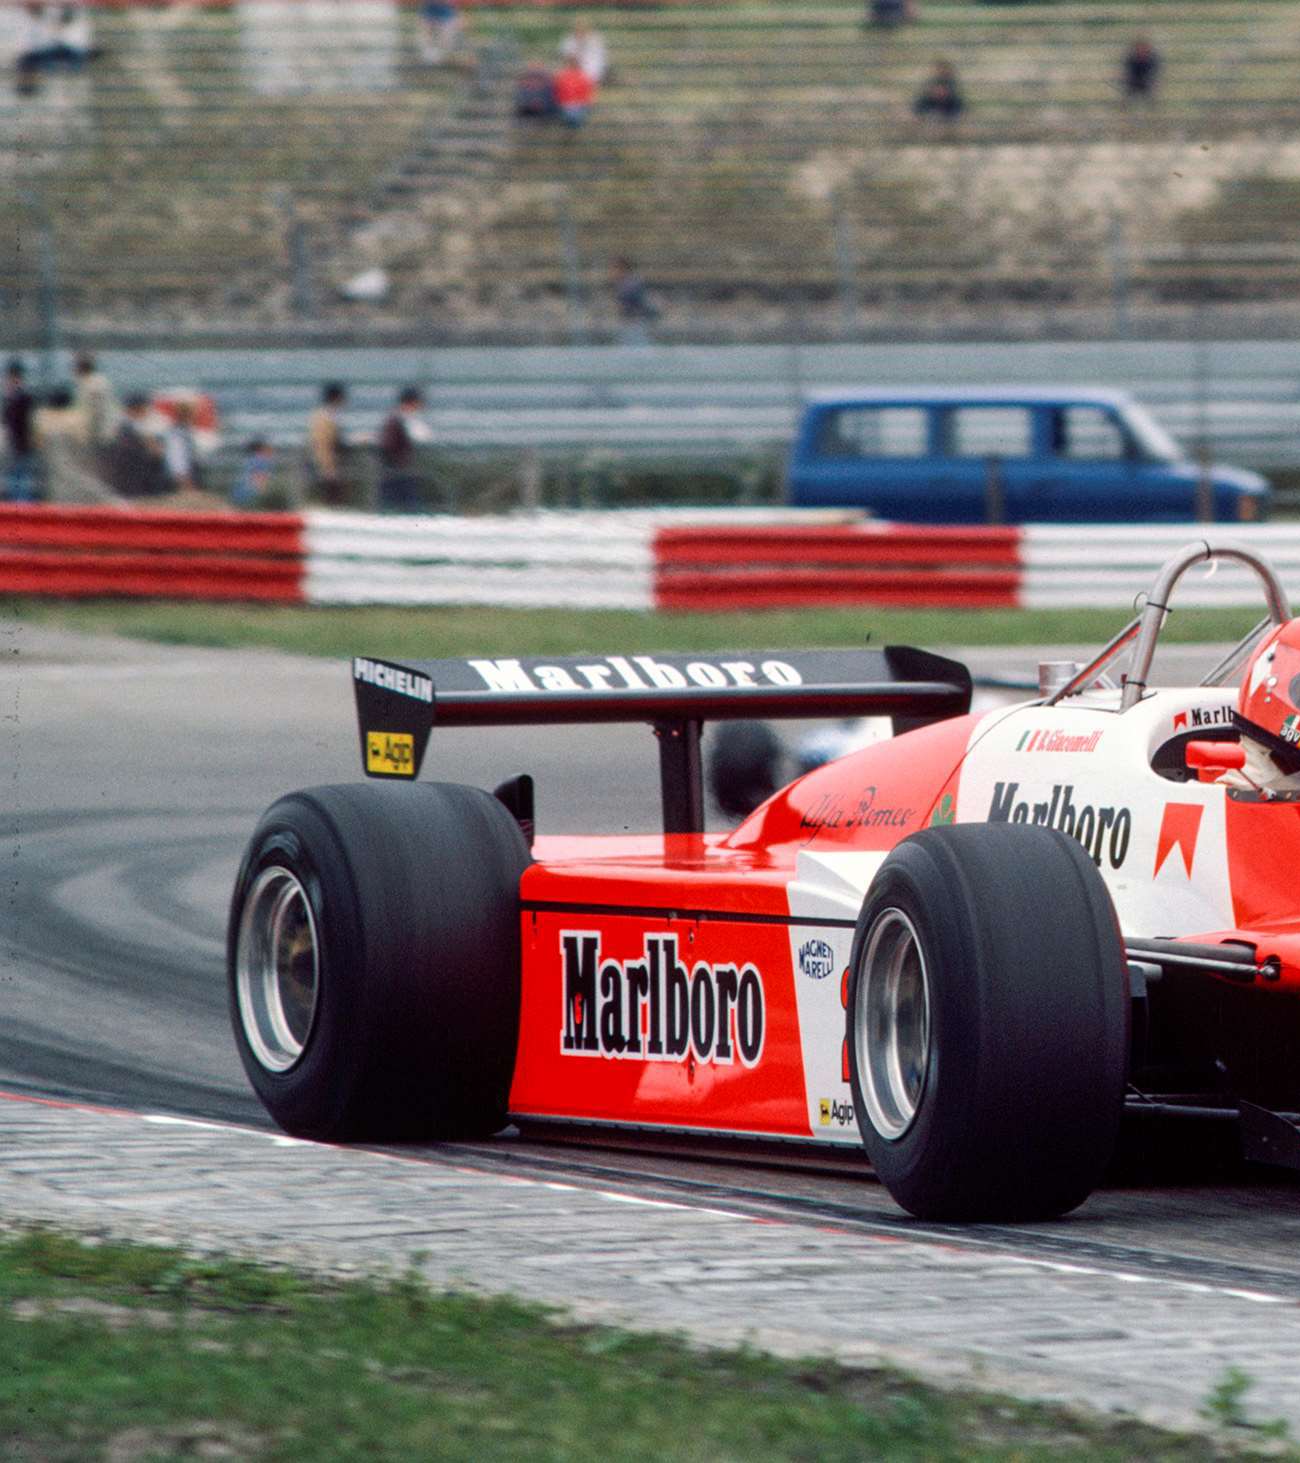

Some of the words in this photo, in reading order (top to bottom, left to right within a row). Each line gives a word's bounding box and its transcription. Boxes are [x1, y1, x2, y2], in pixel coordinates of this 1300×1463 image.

[354, 657, 433, 703] MICHELIN
[468, 656, 802, 692] Marlboro
[560, 930, 764, 1068] Marlboro
[831, 1099, 854, 1126] Agip
